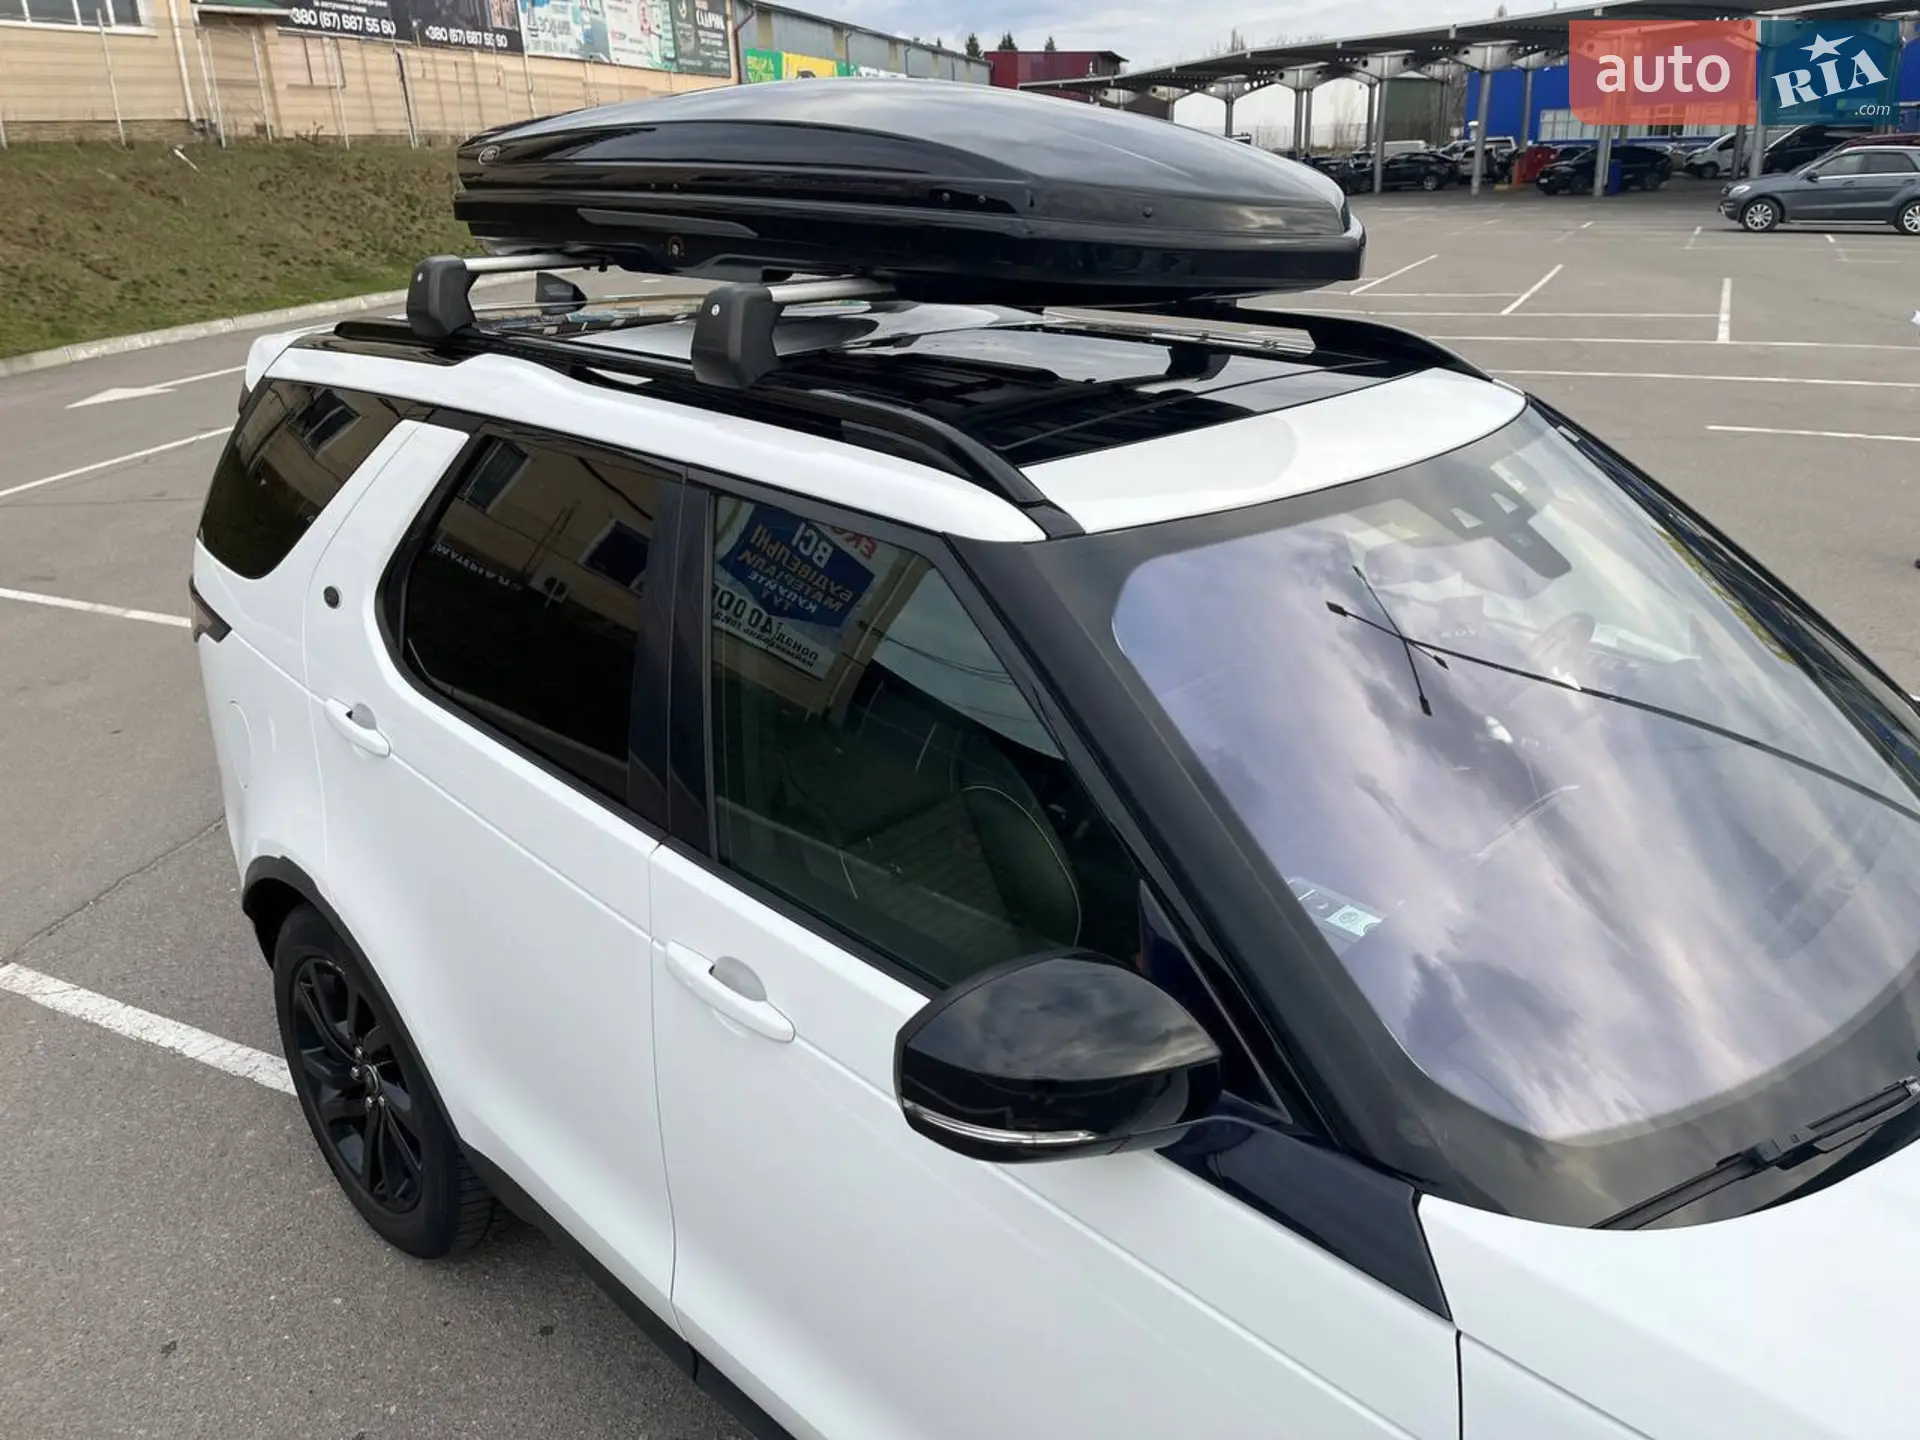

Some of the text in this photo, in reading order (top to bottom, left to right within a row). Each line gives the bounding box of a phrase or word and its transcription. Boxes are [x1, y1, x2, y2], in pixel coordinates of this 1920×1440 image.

[320, 10, 340, 31] (67)
[342, 14, 362, 31] 687
[364, 17, 380, 33] 55
[381, 19, 396, 36] 60
